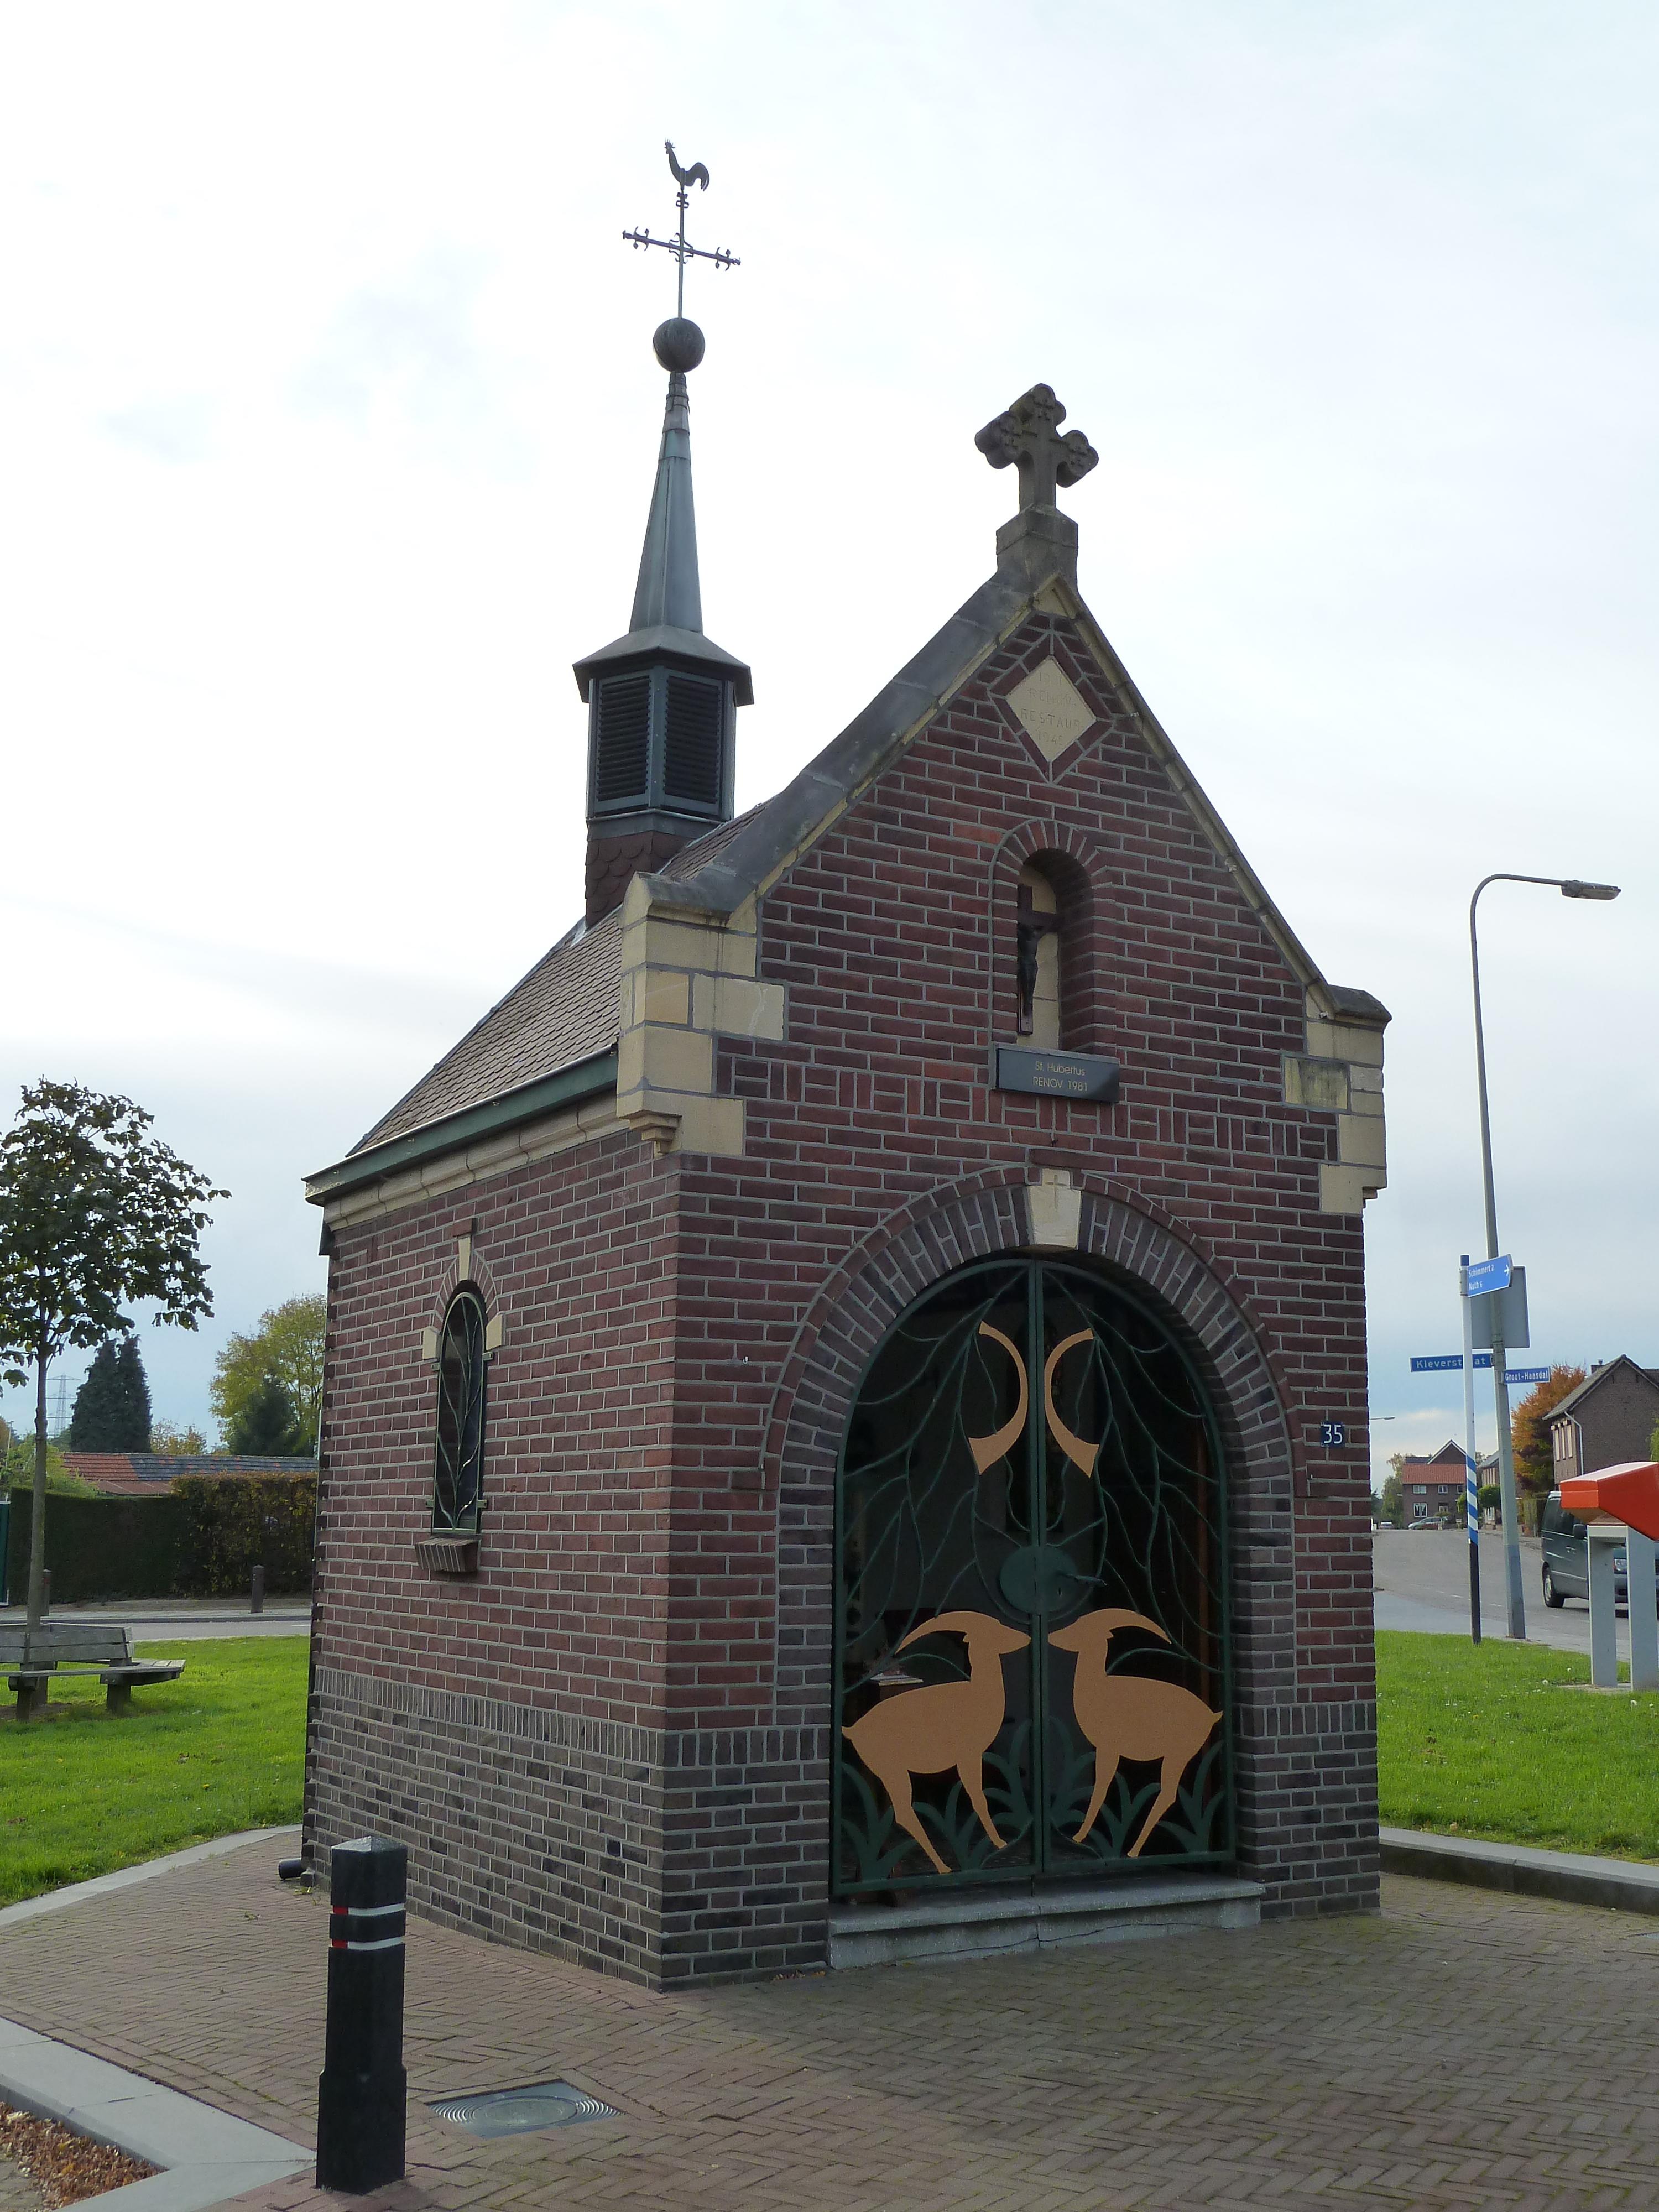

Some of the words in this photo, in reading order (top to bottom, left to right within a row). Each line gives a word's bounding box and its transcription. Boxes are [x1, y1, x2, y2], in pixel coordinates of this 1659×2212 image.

[1047, 1062, 1086, 1076] Hubertus
[1033, 1076, 1063, 1088] RENOV
[1068, 1080, 1087, 1092] 1981
[1468, 1265, 1491, 1278] Schimmert
[1469, 1280, 1479, 1290] Nuth
[1416, 1357, 1486, 1369] Kleverstat
[1505, 1370, 1548, 1381] Groot-Haasdal
[1323, 1424, 1343, 1444] 35
